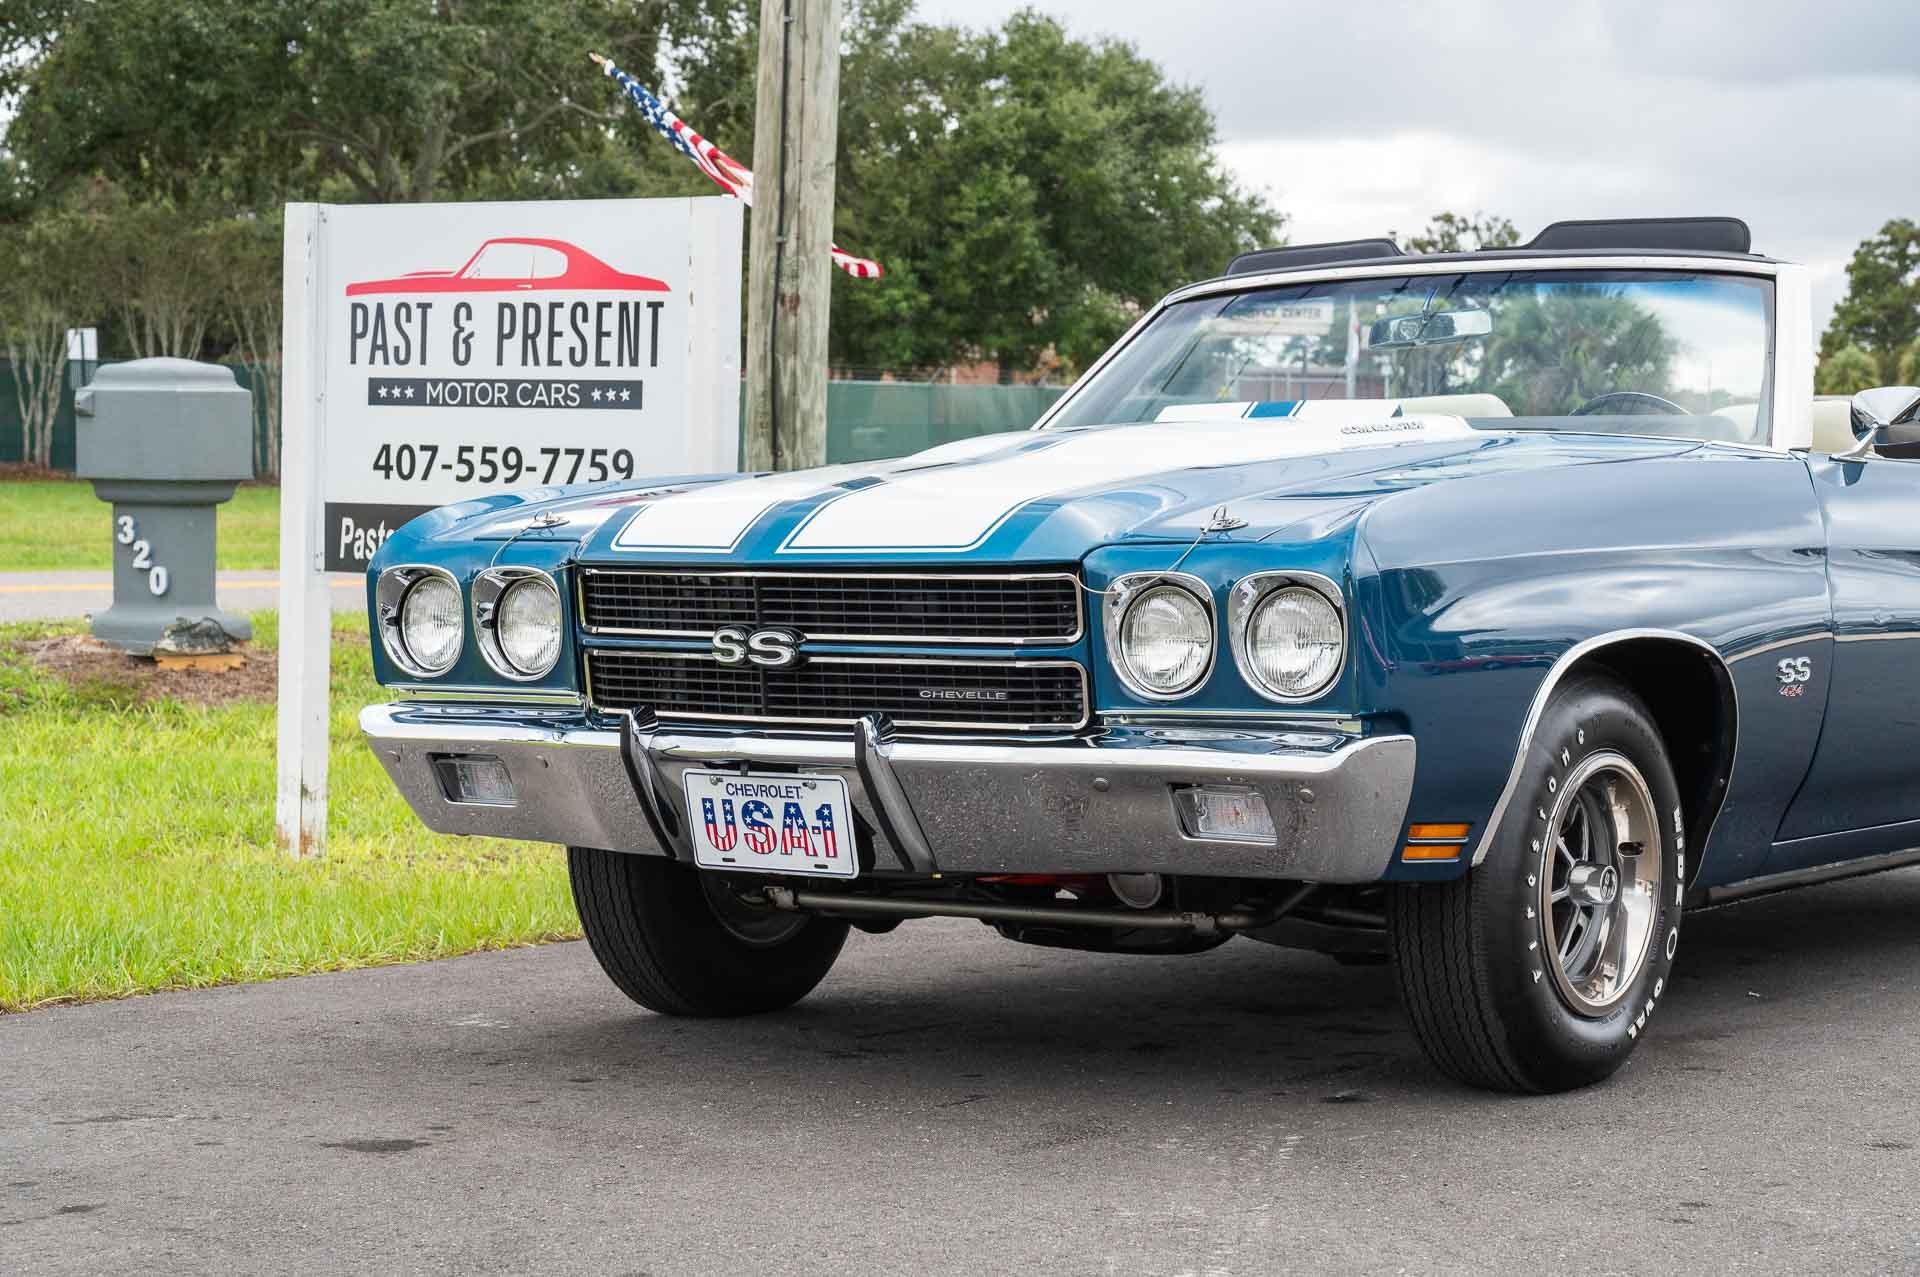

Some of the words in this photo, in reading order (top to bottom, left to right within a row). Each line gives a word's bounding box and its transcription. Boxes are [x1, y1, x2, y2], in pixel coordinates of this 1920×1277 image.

[350, 302, 433, 366] PAST
[452, 302, 475, 367] &
[496, 301, 665, 368] PRESENT
[426, 382, 508, 406] MOTOR
[516, 383, 581, 407] CARS
[372, 443, 634, 485] 407-559-7759
[117, 515, 168, 596] 320
[712, 625, 800, 665] SS
[1777, 656, 1811, 683] SS
[919, 689, 1008, 701] CHEVELLE
[725, 782, 801, 800] CHEVROLET
[701, 797, 838, 858] USA-1
[1627, 976, 1664, 1040] OVAL
